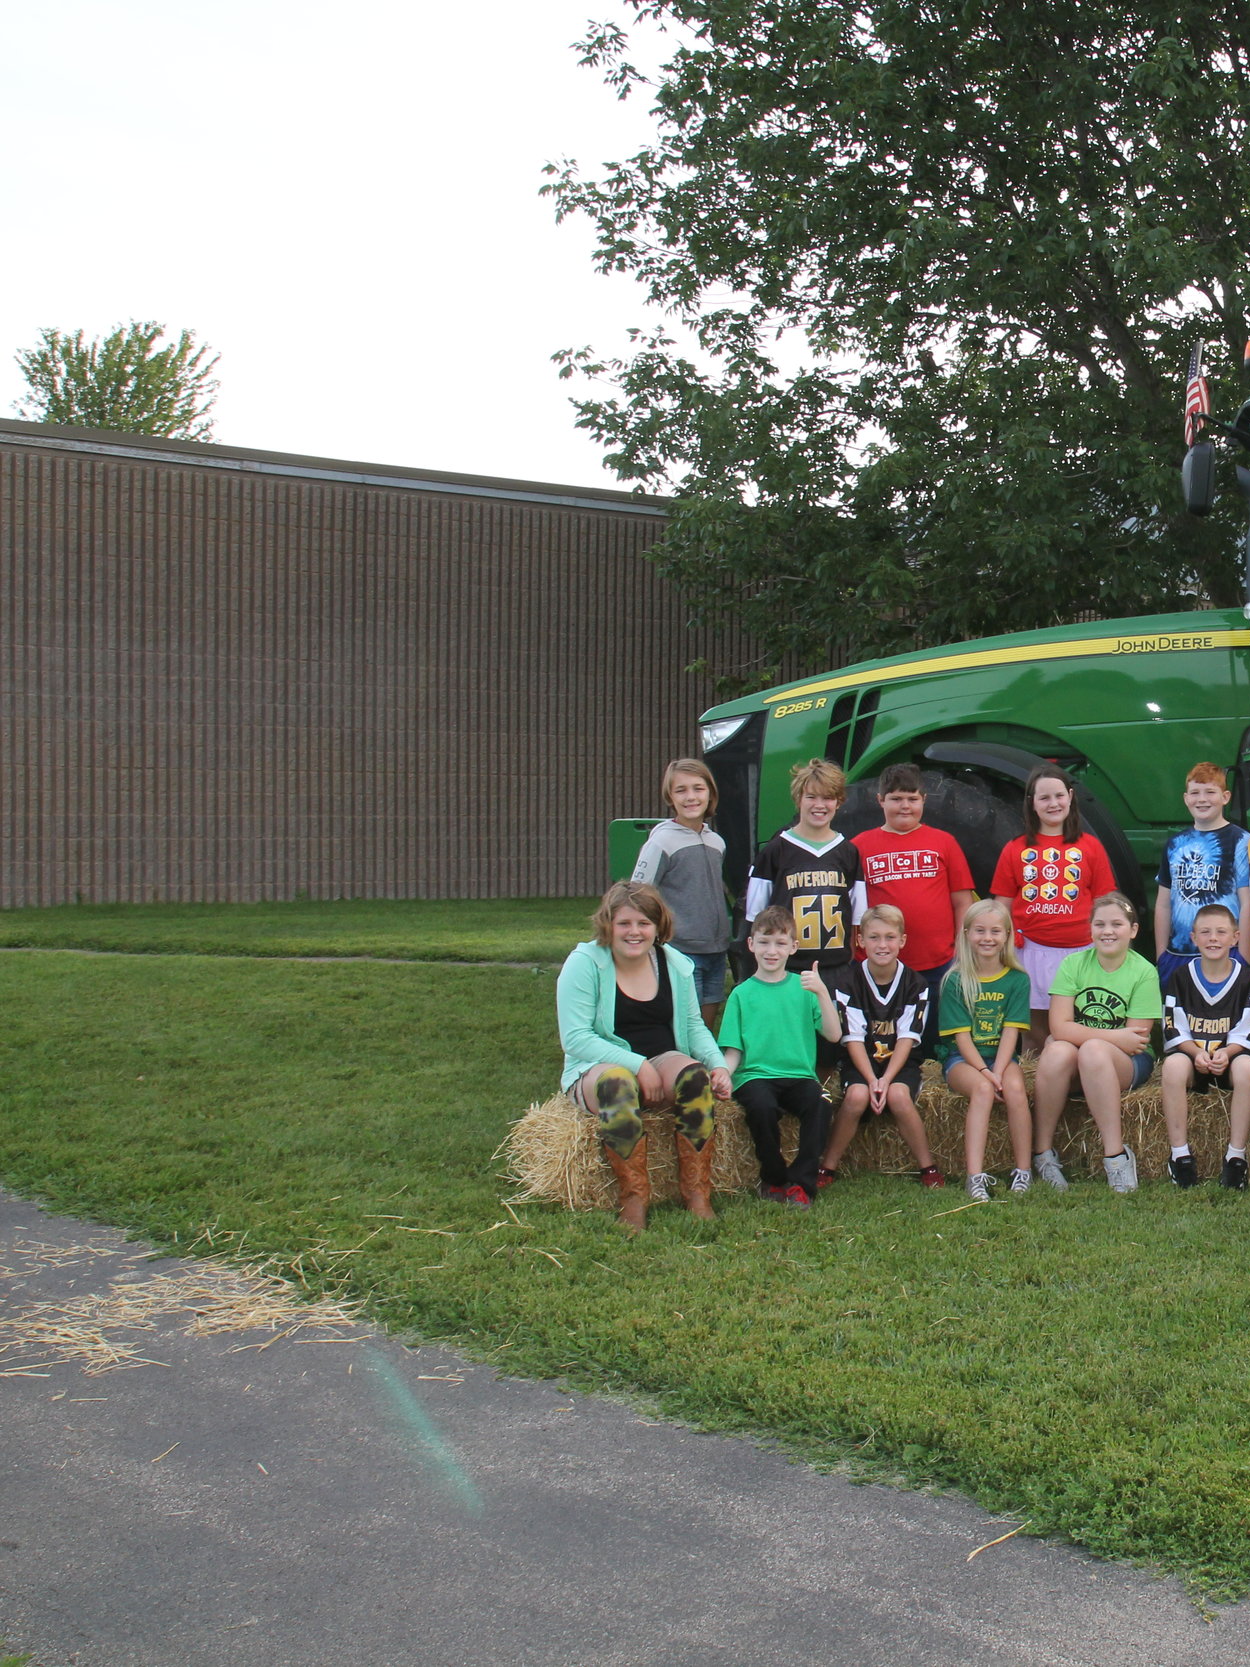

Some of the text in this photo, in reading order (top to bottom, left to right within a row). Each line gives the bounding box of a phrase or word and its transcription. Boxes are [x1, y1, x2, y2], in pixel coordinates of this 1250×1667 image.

[1112, 637, 1213, 653] JOHN DEERE
[774, 697, 828, 719] 8285 R
[872, 855, 932, 870] Ba Co N
[885, 873, 903, 881] BACON
[913, 871, 921, 879] MY
[1025, 903, 1073, 915] CARIBBEAN
[792, 894, 846, 950] 65
